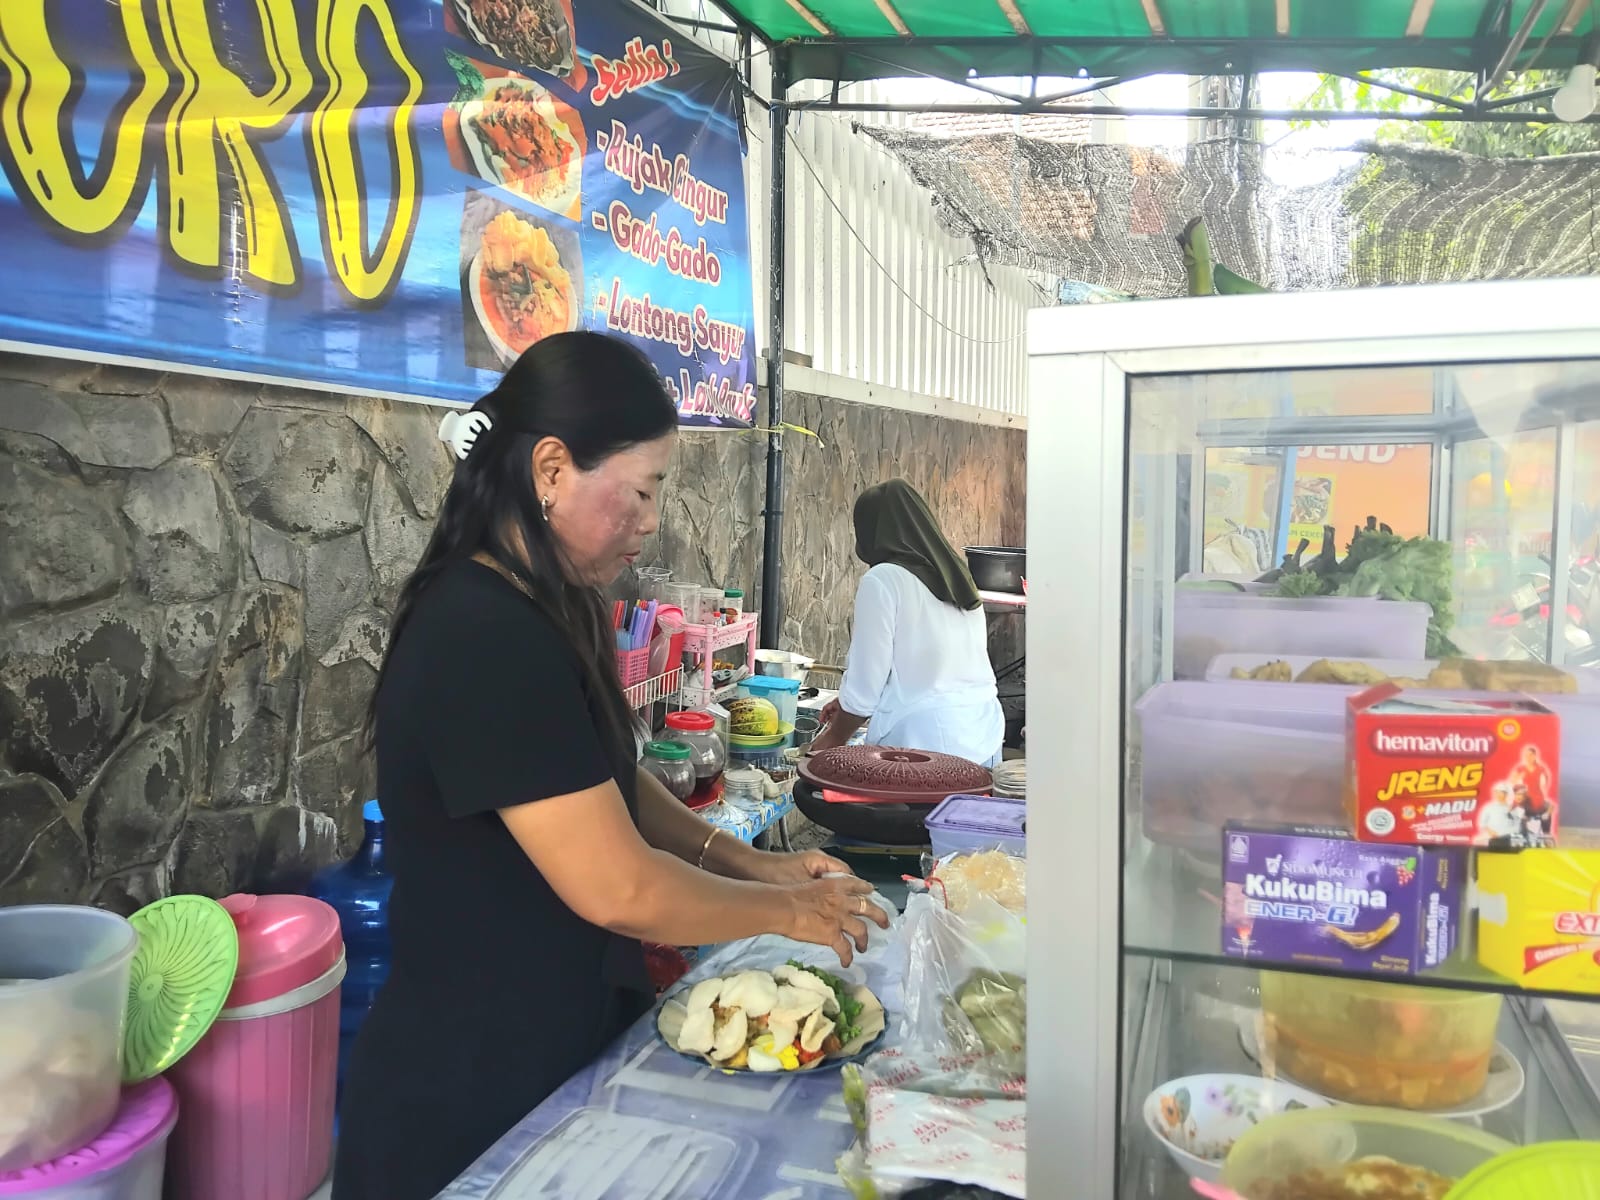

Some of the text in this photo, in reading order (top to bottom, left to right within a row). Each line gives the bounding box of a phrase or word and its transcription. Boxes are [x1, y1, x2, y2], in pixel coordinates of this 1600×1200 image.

[672, 153, 728, 223] Cingur
[693, 303, 746, 365] Sayur
[1376, 728, 1489, 753] hemaviton
[1377, 762, 1484, 801] JRENG
[1425, 799, 1477, 817] MADU
[1245, 873, 1388, 909] KukuBima
